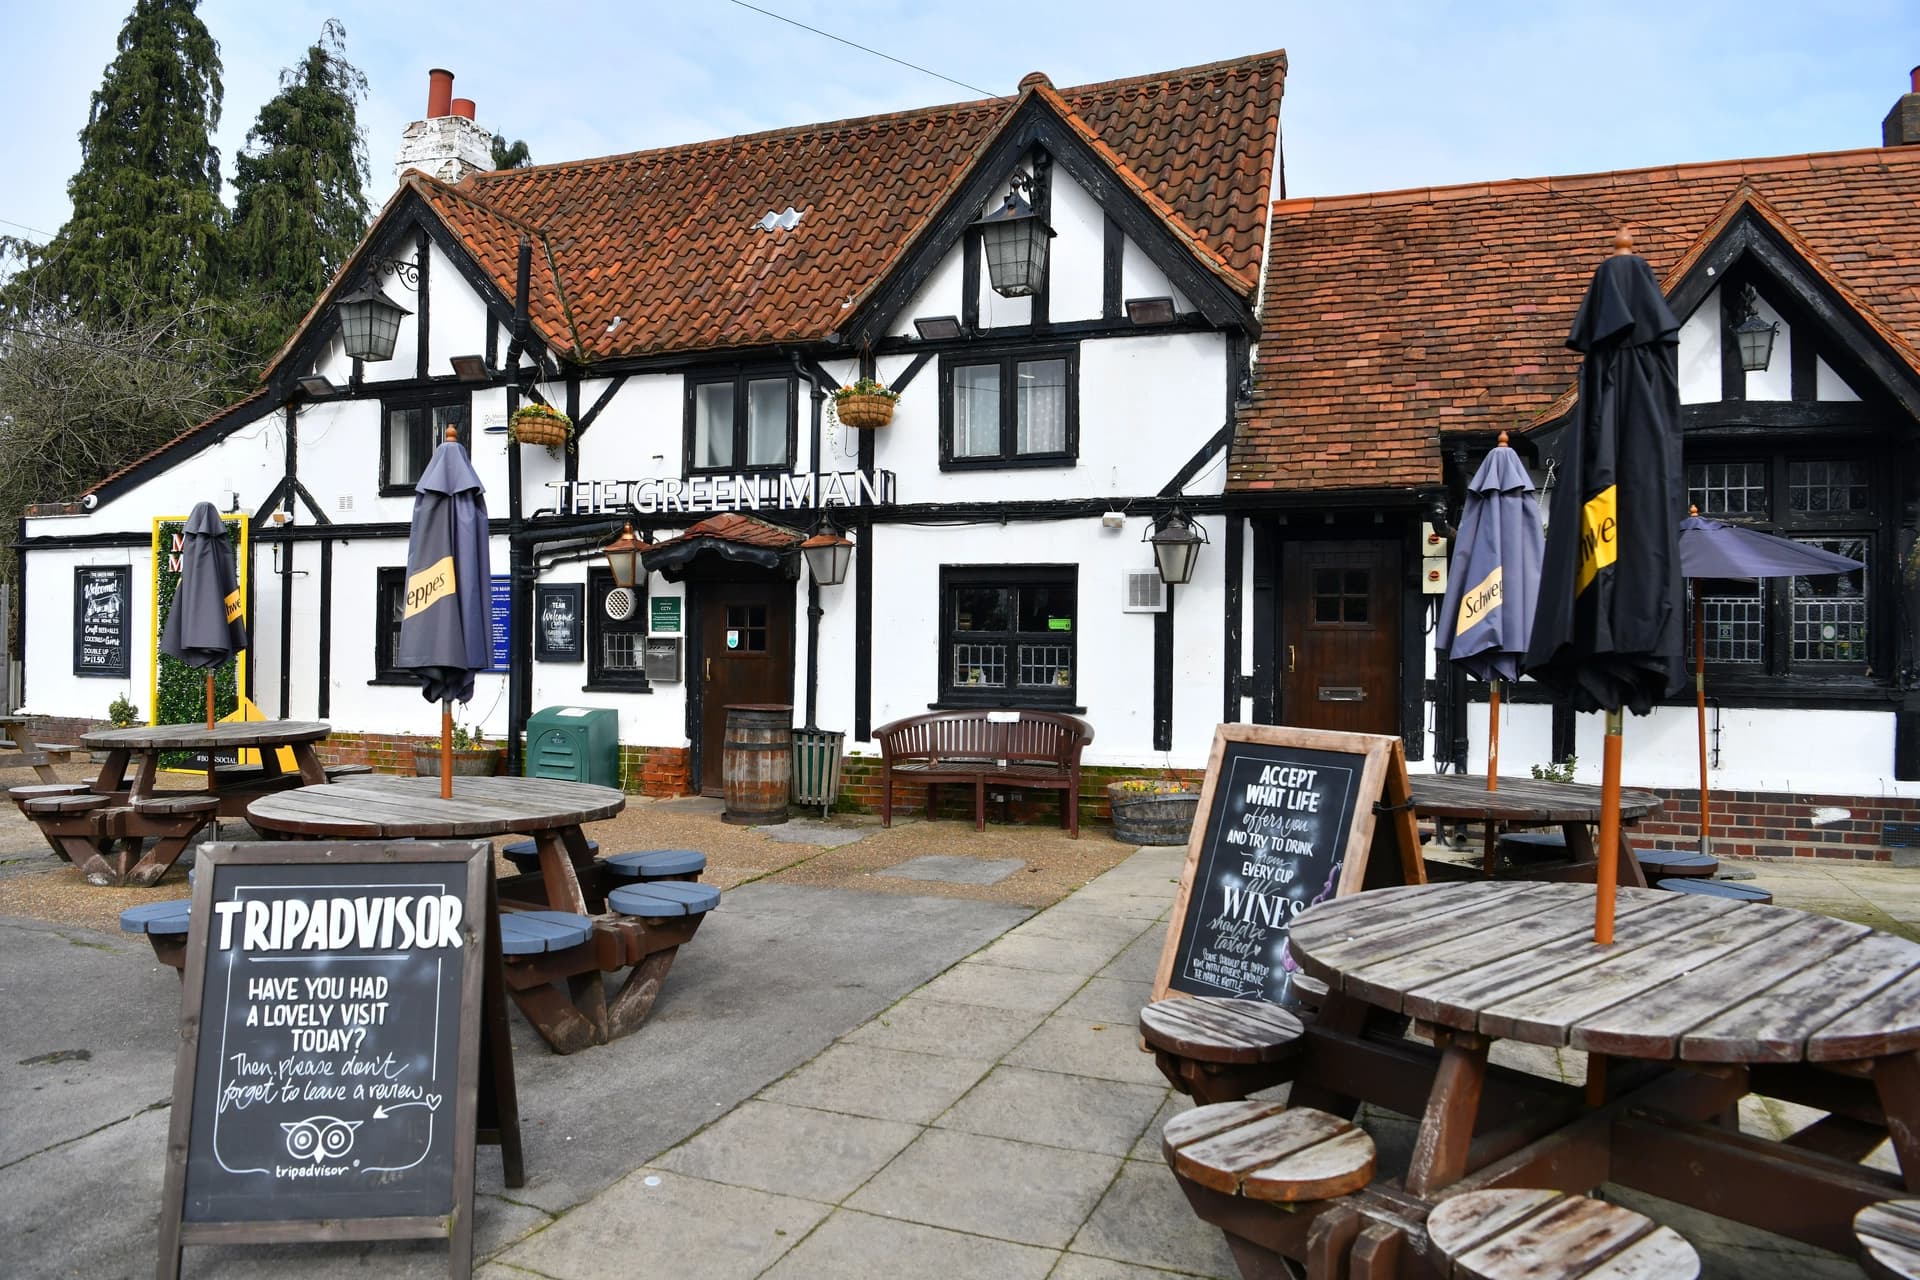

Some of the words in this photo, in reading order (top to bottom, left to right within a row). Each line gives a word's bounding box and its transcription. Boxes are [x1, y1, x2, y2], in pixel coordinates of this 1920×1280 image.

[547, 480, 617, 515] THE
[632, 474, 761, 514] GREEN
[778, 468, 883, 511] MAN
[84, 579, 118, 599] Welcome!
[406, 572, 446, 609] eppes
[1259, 765, 1317, 790] ACCEPT
[1245, 784, 1286, 808] WHAT
[1287, 790, 1320, 812] LIFE
[1243, 807, 1282, 833] offers
[1281, 817, 1310, 838] you
[1226, 829, 1247, 845] AND
[1248, 832, 1269, 848] TRY
[1271, 836, 1284, 851] TO
[1285, 838, 1314, 857] DRINK
[1242, 861, 1275, 880] EVERY
[1274, 868, 1294, 883] CUP
[215, 894, 464, 951] TRIPADVISOR
[1206, 913, 1250, 939] should
[1249, 920, 1267, 941] be
[1214, 932, 1255, 960] tasted
[249, 977, 299, 1000] HAVE
[304, 977, 344, 1000] YOU
[349, 976, 389, 1000] HAD
[246, 1004, 258, 1027] A
[263, 1003, 334, 1027] LOVELY
[340, 1002, 389, 1026] VISIT
[291, 1028, 367, 1054] TODAY?
[278, 1055, 334, 1081] please
[340, 1051, 409, 1080] don't
[219, 1075, 279, 1114] forget
[281, 1077, 301, 1104] to
[303, 1080, 347, 1101] leave
[353, 1083, 365, 1100] a
[369, 1080, 424, 1101] review
[275, 1163, 350, 1181] tripadvisor
